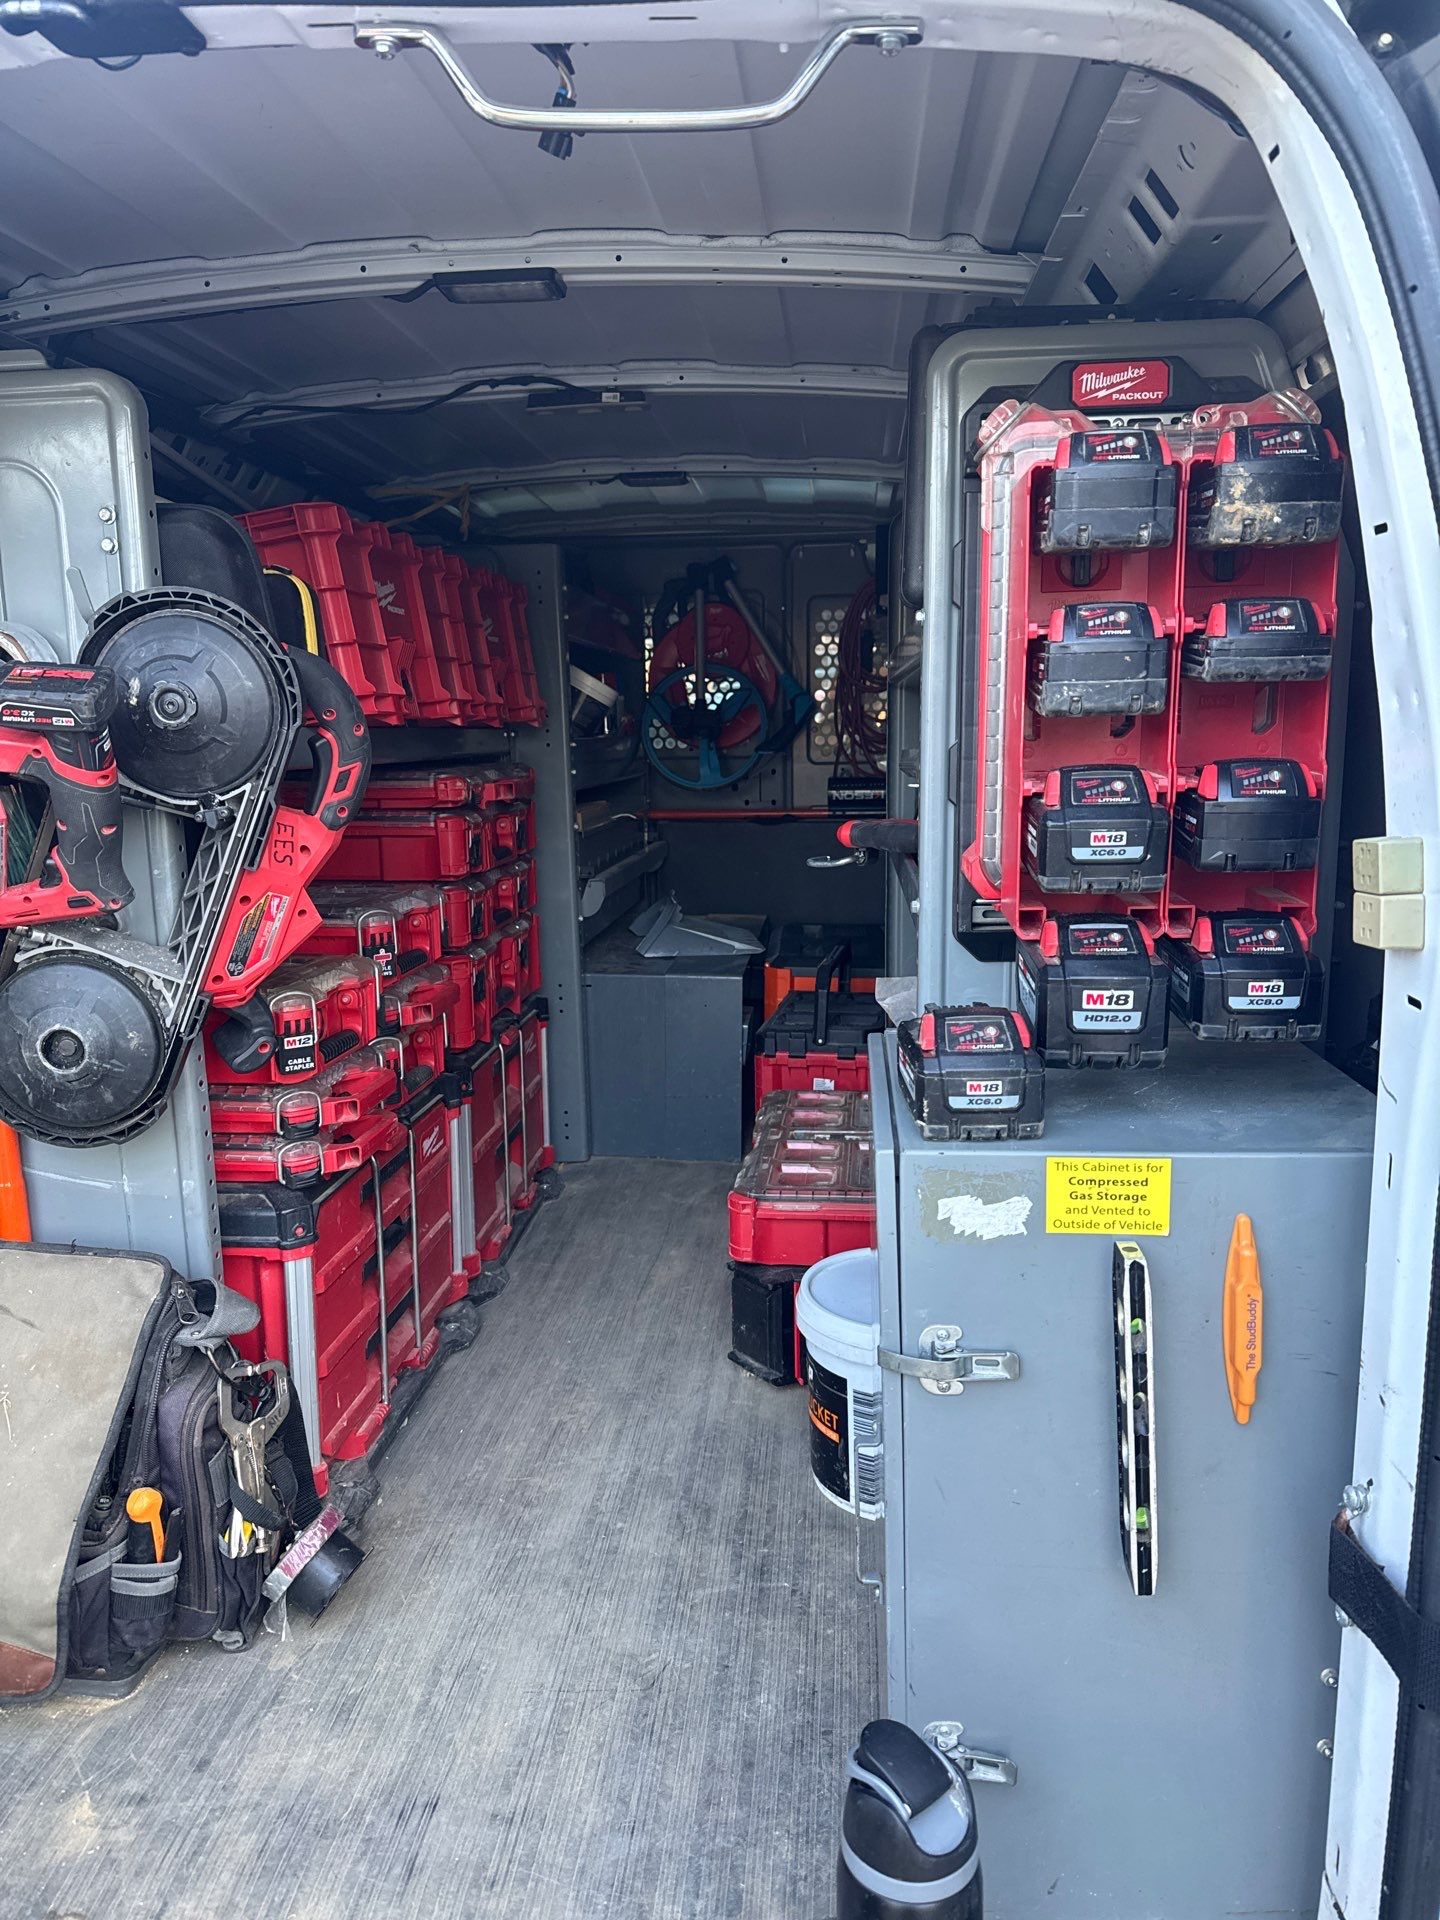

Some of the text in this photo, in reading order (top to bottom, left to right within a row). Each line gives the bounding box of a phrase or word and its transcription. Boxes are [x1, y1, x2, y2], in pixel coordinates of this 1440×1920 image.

[1079, 365, 1146, 393] Milwaukee
[1112, 391, 1164, 401] PACKOUT
[273, 821, 295, 867] EES
[1092, 833, 1125, 844] M18
[1090, 848, 1127, 857] XC6.0
[1250, 984, 1282, 993] M18
[1085, 993, 1131, 1006] M18
[1246, 998, 1284, 1006] XC8.0
[1084, 1014, 1132, 1023] HD12.0
[285, 1036, 312, 1048] M12
[287, 1056, 312, 1066] CABLE
[285, 1062, 315, 1072] STAPLER
[968, 1083, 1000, 1093] M18
[966, 1097, 1003, 1105] XC6.0
[1054, 1161, 1164, 1173] This Cabinet is for
[1068, 1176, 1149, 1188] Compressed
[1069, 1190, 1148, 1203] Gas Storage
[1065, 1205, 1151, 1216] and Vented to
[1053, 1218, 1163, 1231] Outside of Vehicle
[1246, 1353, 1256, 1371] The
